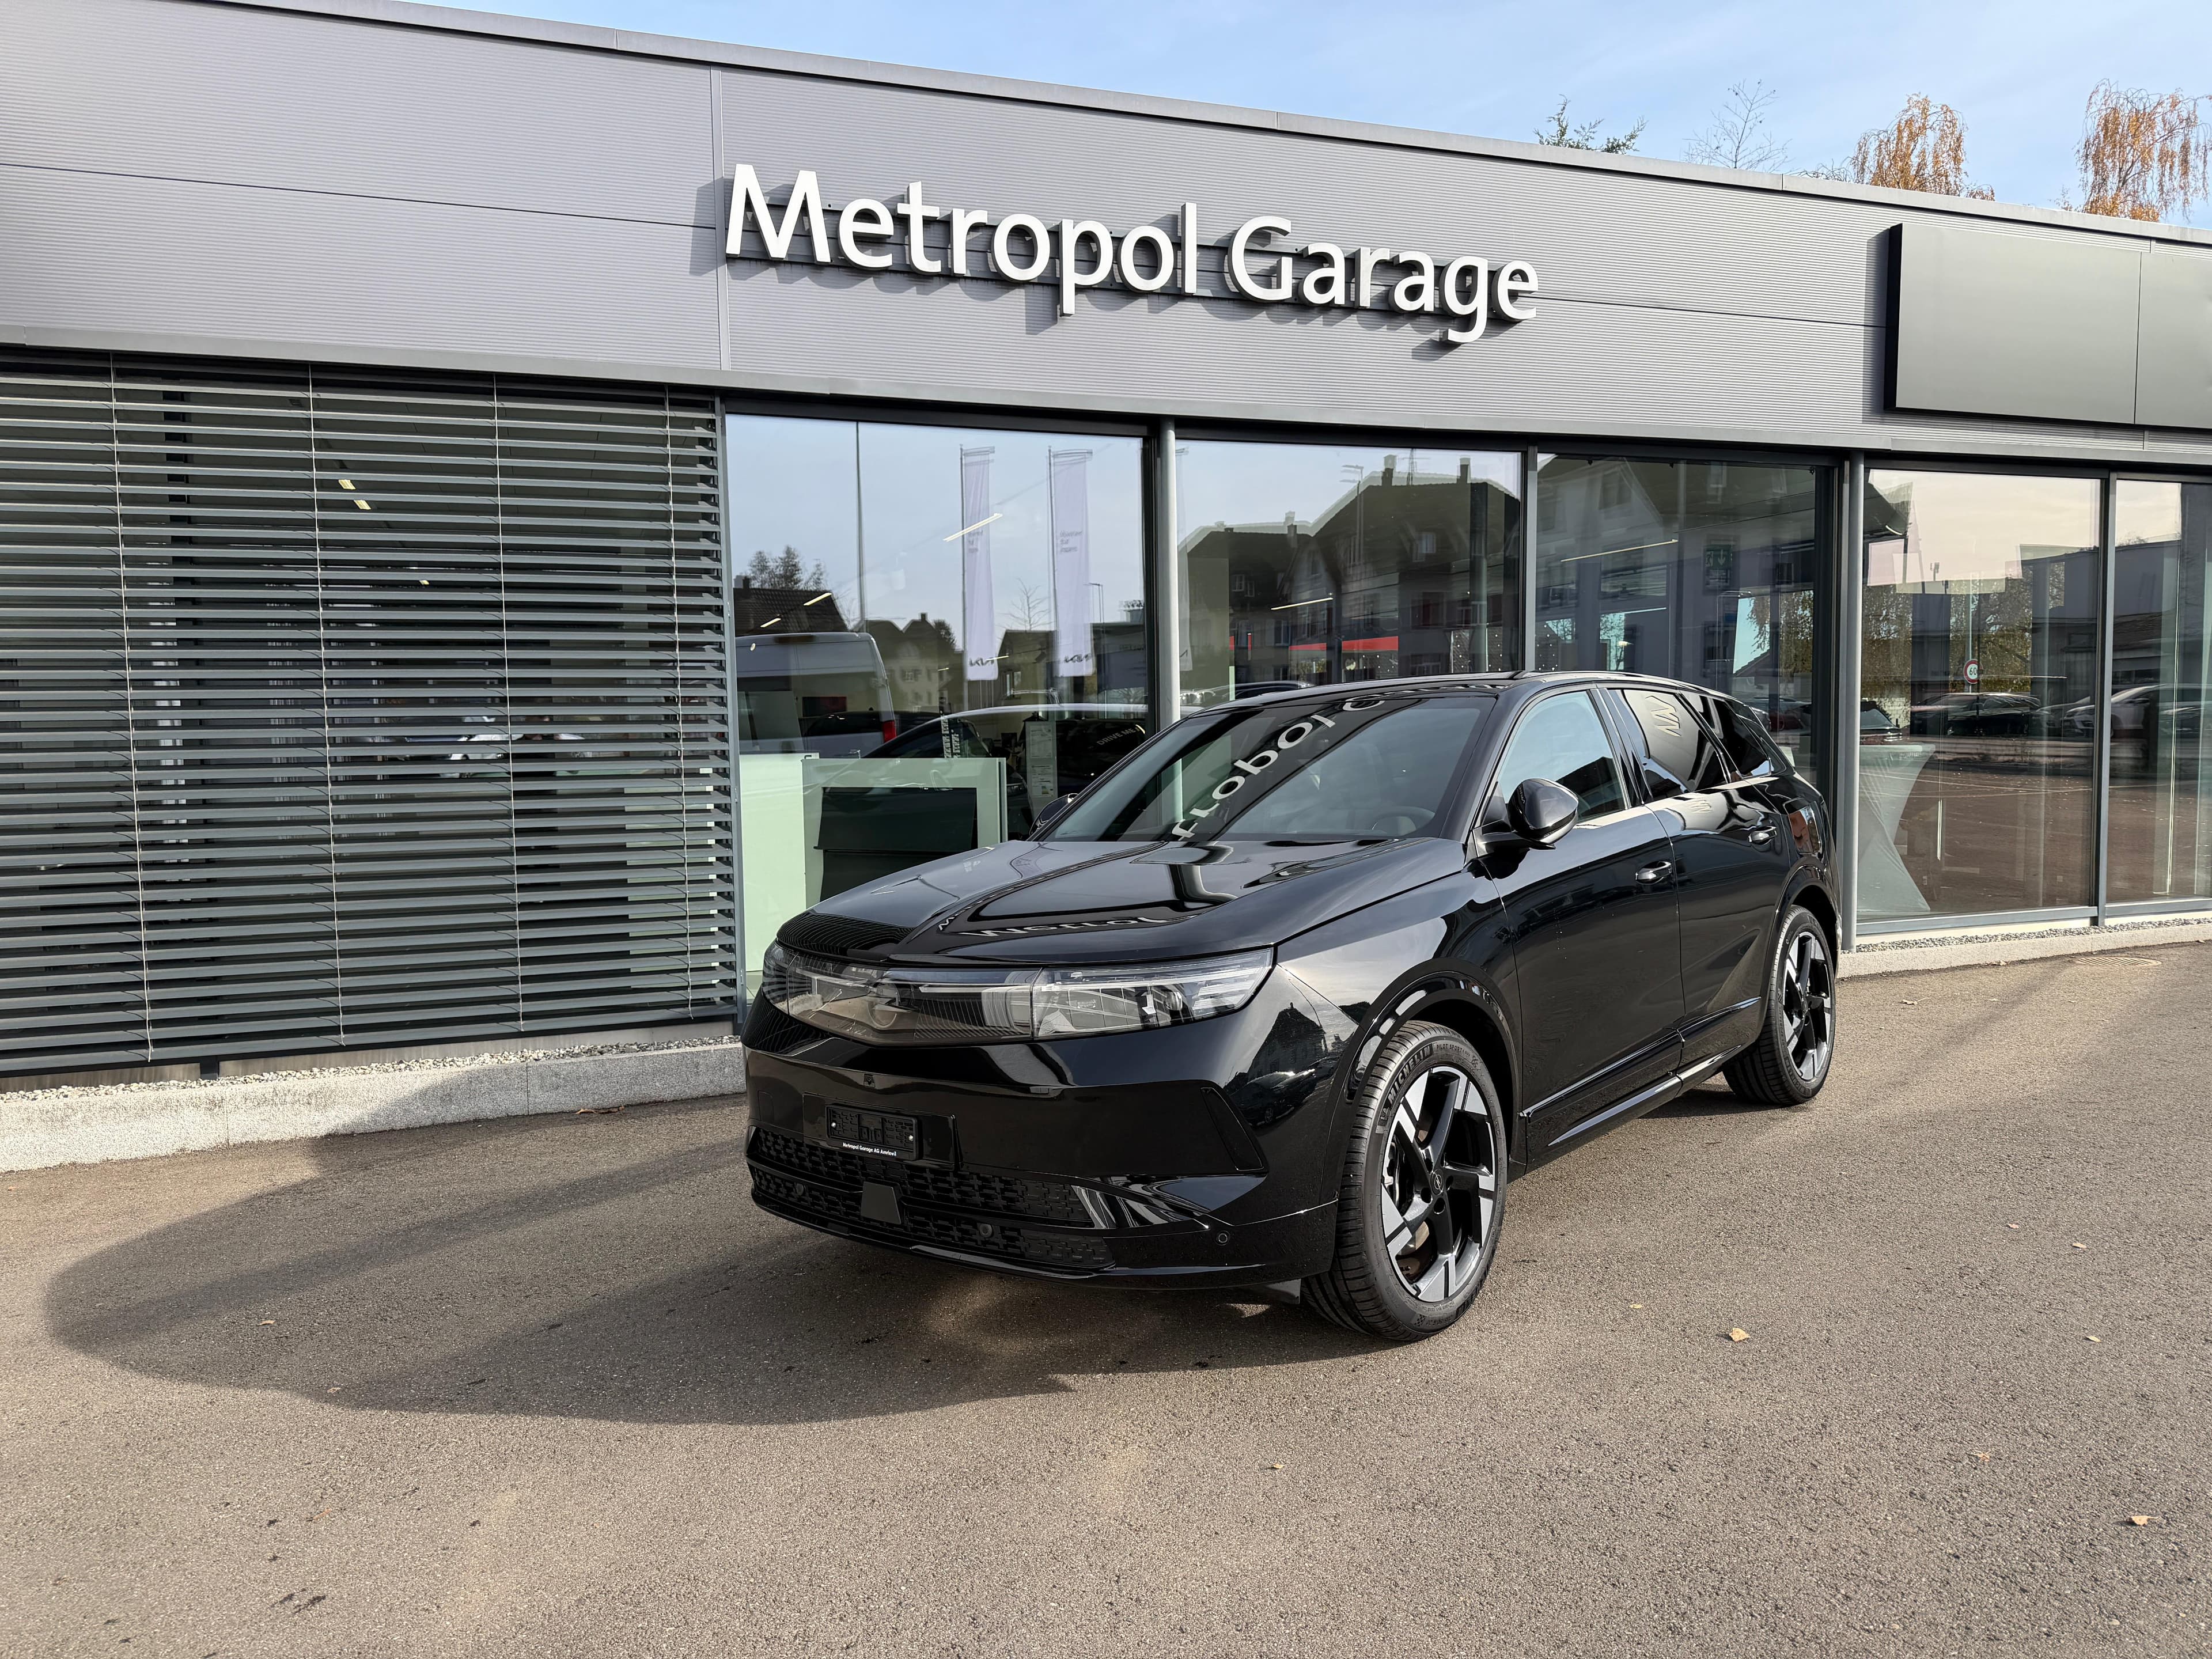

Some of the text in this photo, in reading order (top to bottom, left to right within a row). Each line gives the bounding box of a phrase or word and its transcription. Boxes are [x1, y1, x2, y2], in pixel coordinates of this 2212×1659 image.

[726, 164, 1539, 344] Metropol Garage
[1969, 667, 1977, 675] 60
[1097, 732, 1123, 745] DRIVE
[1388, 1045, 1432, 1105] MICHELIN
[1449, 1044, 1463, 1053] SPORT
